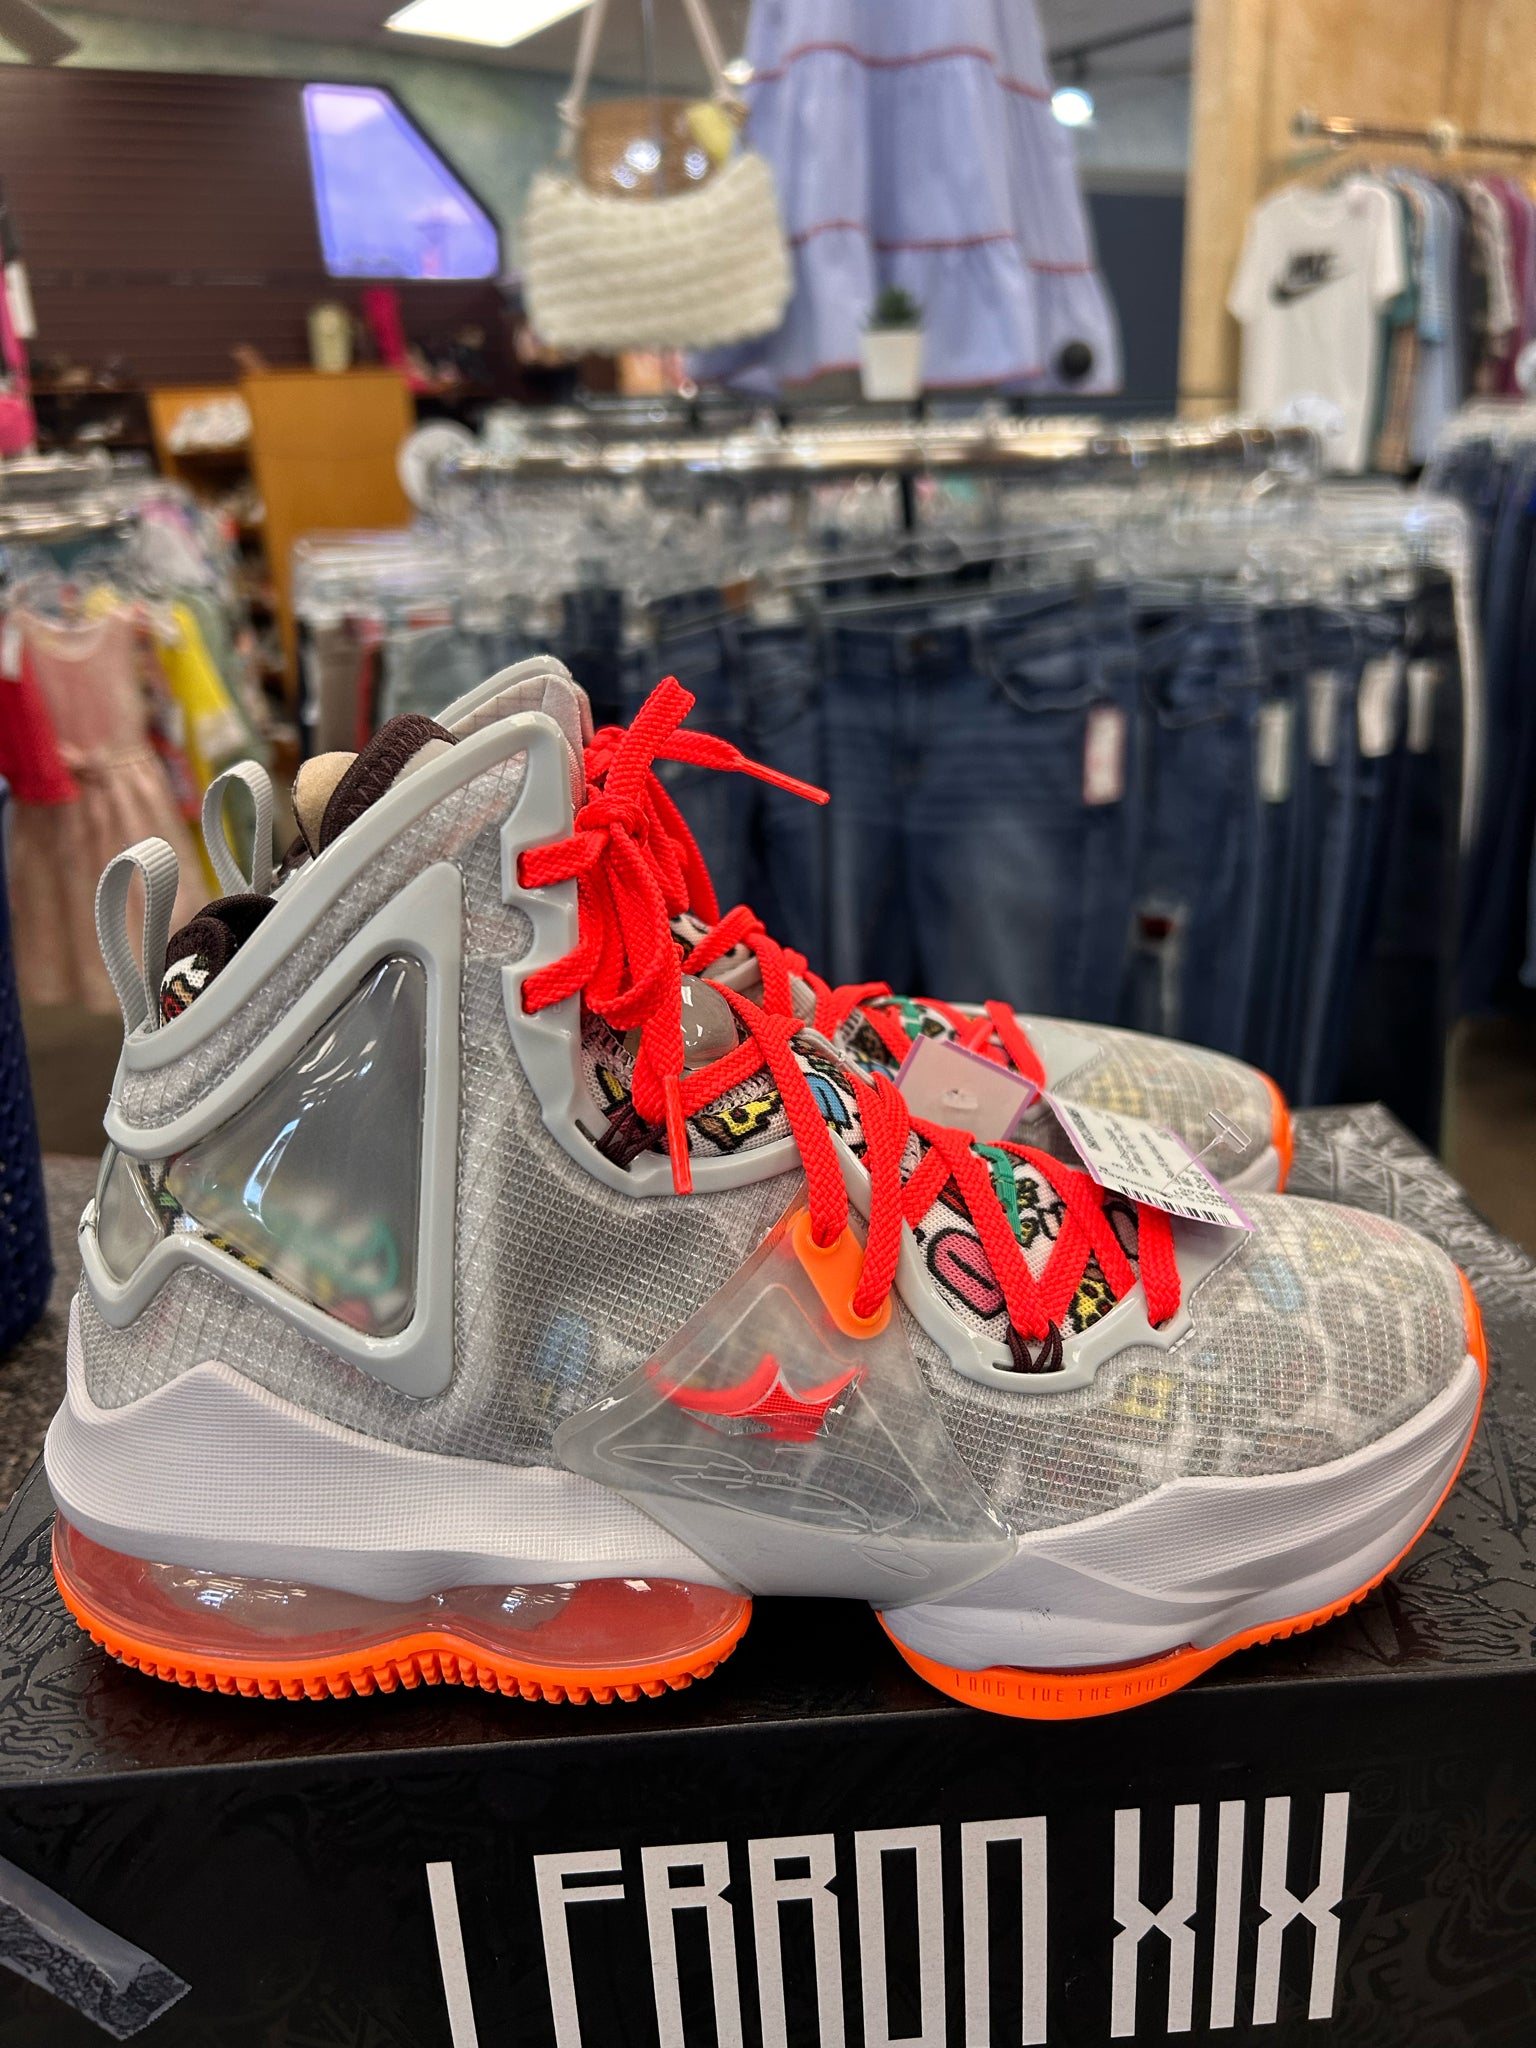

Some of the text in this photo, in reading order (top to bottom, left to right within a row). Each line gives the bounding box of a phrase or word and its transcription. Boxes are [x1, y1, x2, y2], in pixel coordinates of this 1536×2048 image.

[955, 1672, 1169, 1702] LONG LIVE THE KING
[1110, 1792, 1350, 2038] XIX
